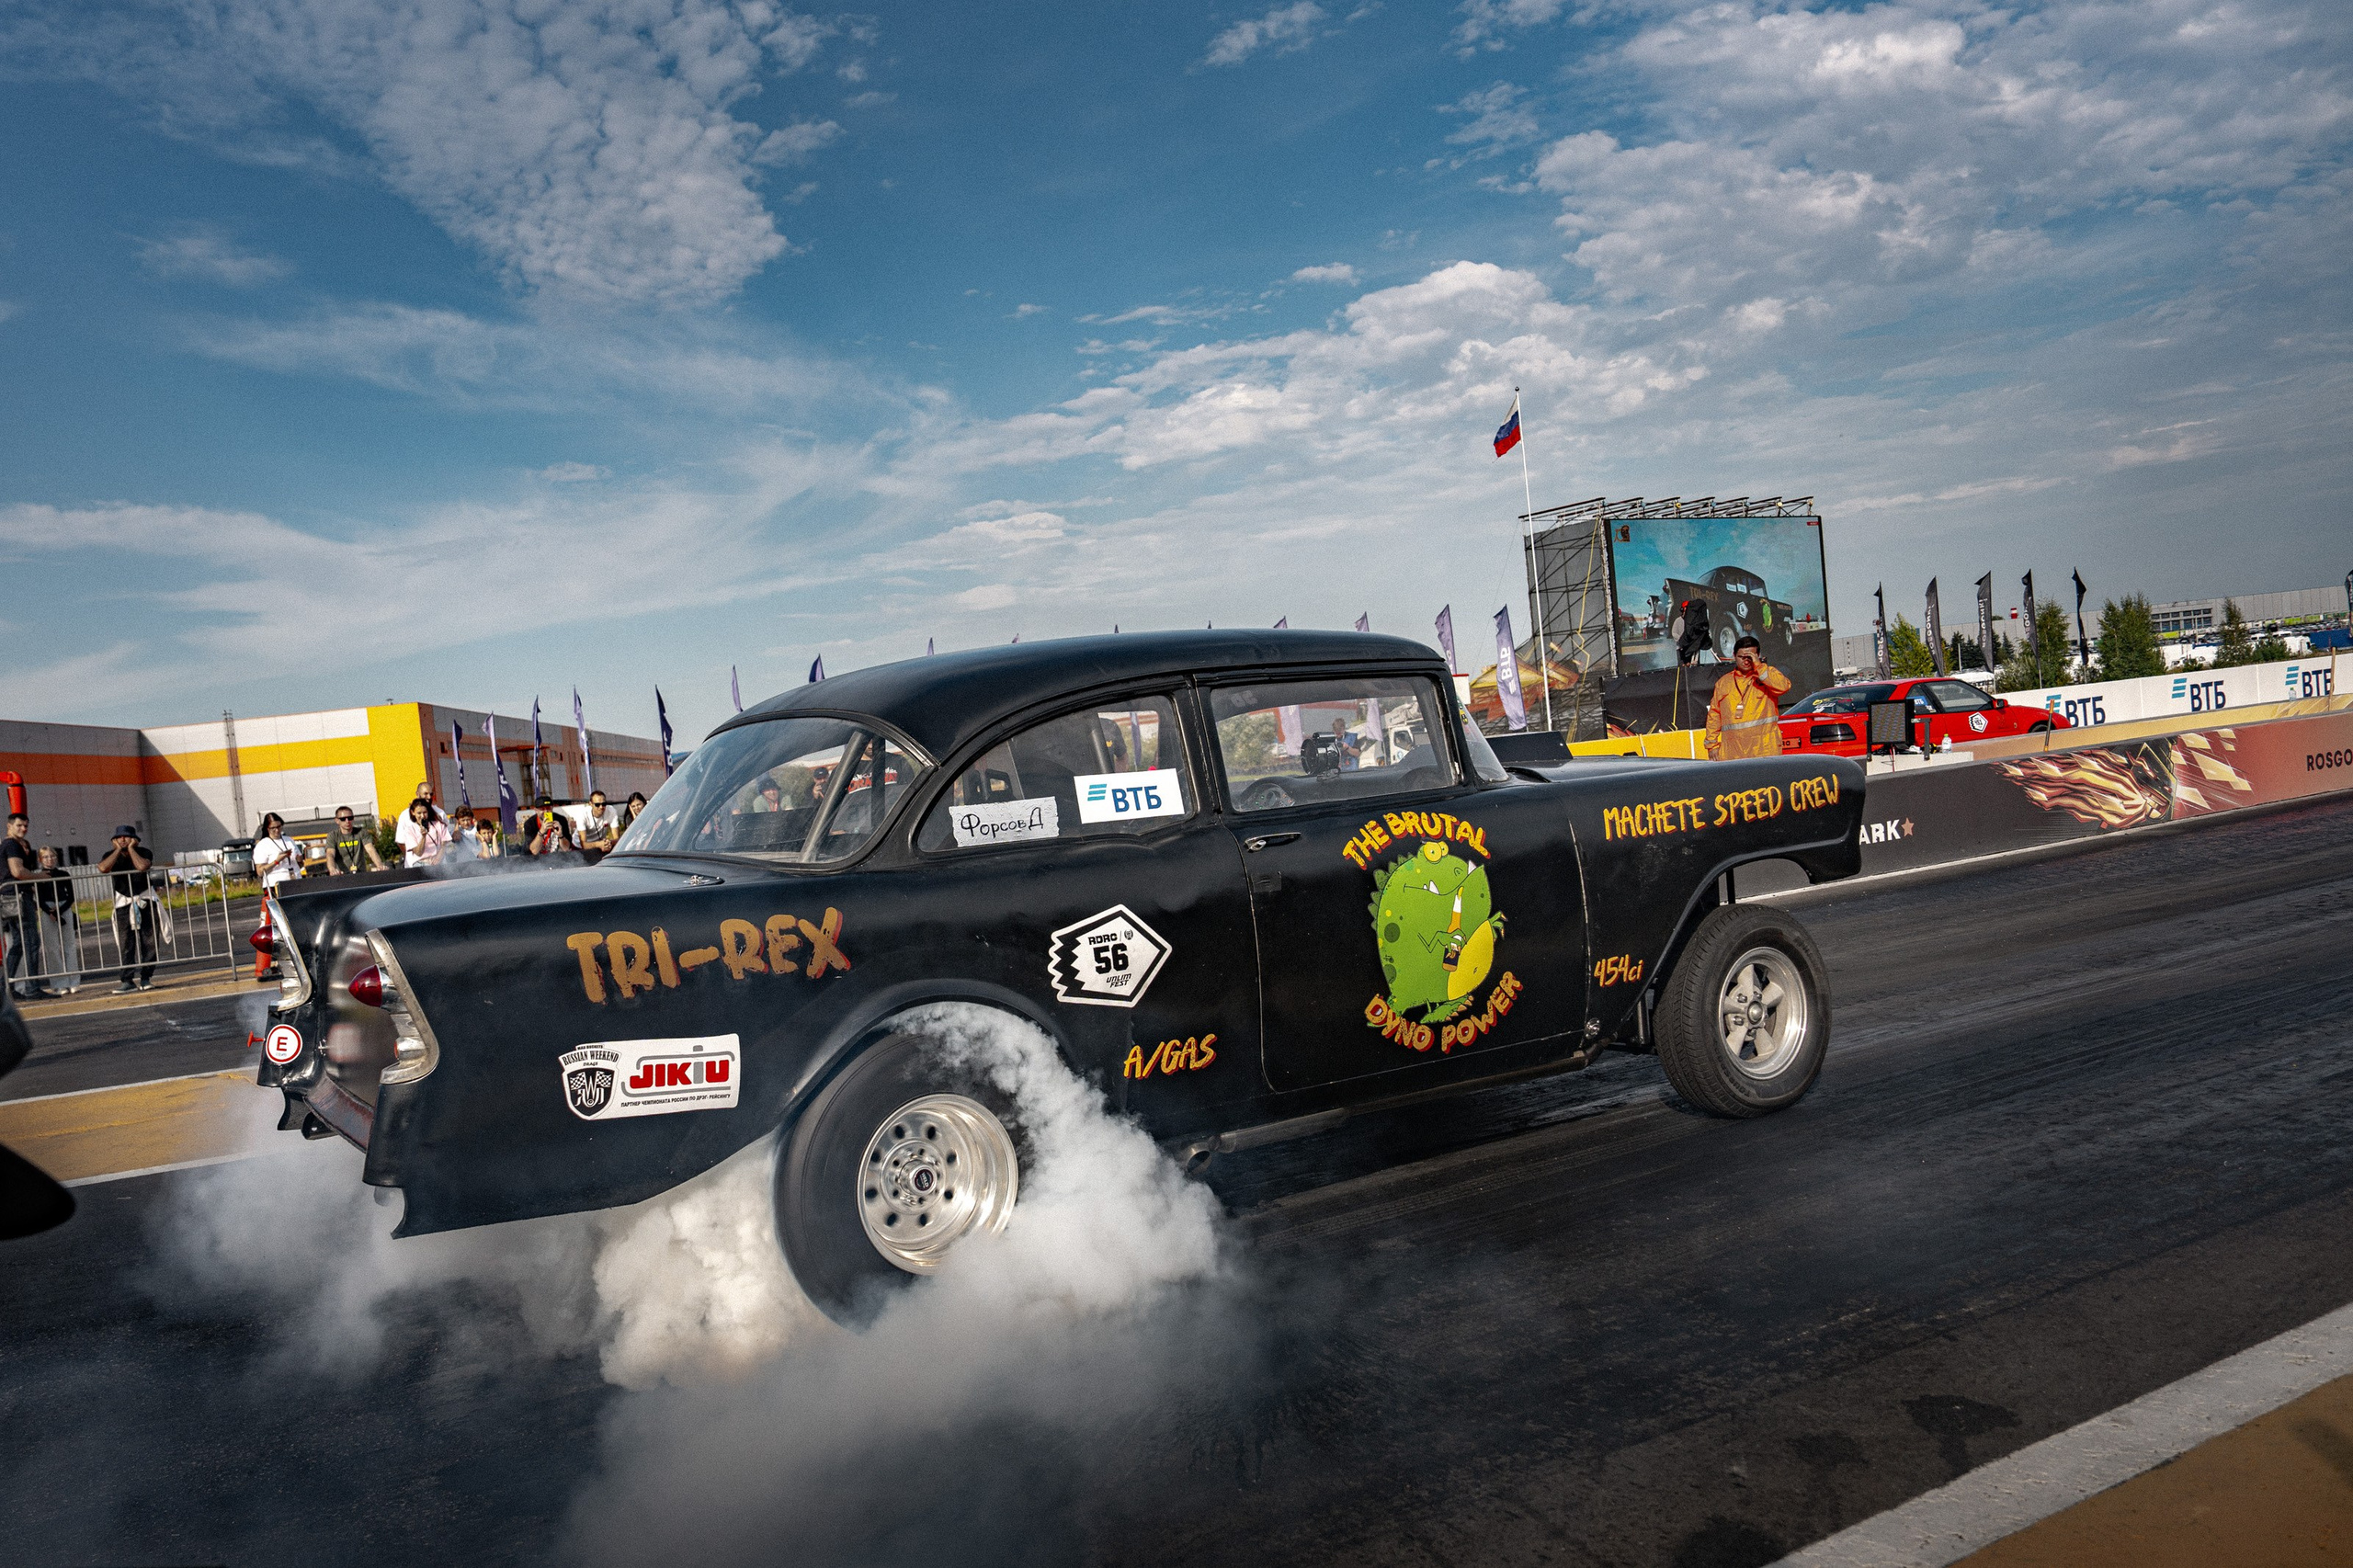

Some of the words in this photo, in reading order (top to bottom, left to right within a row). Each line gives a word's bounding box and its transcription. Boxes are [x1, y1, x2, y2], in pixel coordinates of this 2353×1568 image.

[2064, 695, 2107, 728] ВТБ
[2190, 680, 2226, 712] ВТБ
[2306, 748, 2353, 771] ROSGO
[1111, 785, 1163, 812] ВТБ
[1603, 796, 1707, 842] MACHETE
[1712, 786, 1784, 827] SPEED
[1790, 773, 1840, 813] CREW
[1342, 820, 1392, 870] THE
[1382, 811, 1492, 859] BRUTAL
[1088, 933, 1118, 946] RDRC
[566, 906, 851, 1006] TRI-REX
[1093, 942, 1130, 974] 56
[1594, 954, 1644, 988] 454ci
[1109, 980, 1130, 989] FEST
[1364, 994, 1436, 1052] DYNO
[1441, 971, 1524, 1054] POWER
[277, 1036, 289, 1051] E
[562, 1051, 588, 1066] RUSSIAN
[590, 1051, 620, 1062] WEEKEND
[1123, 1033, 1218, 1081] A/GAS
